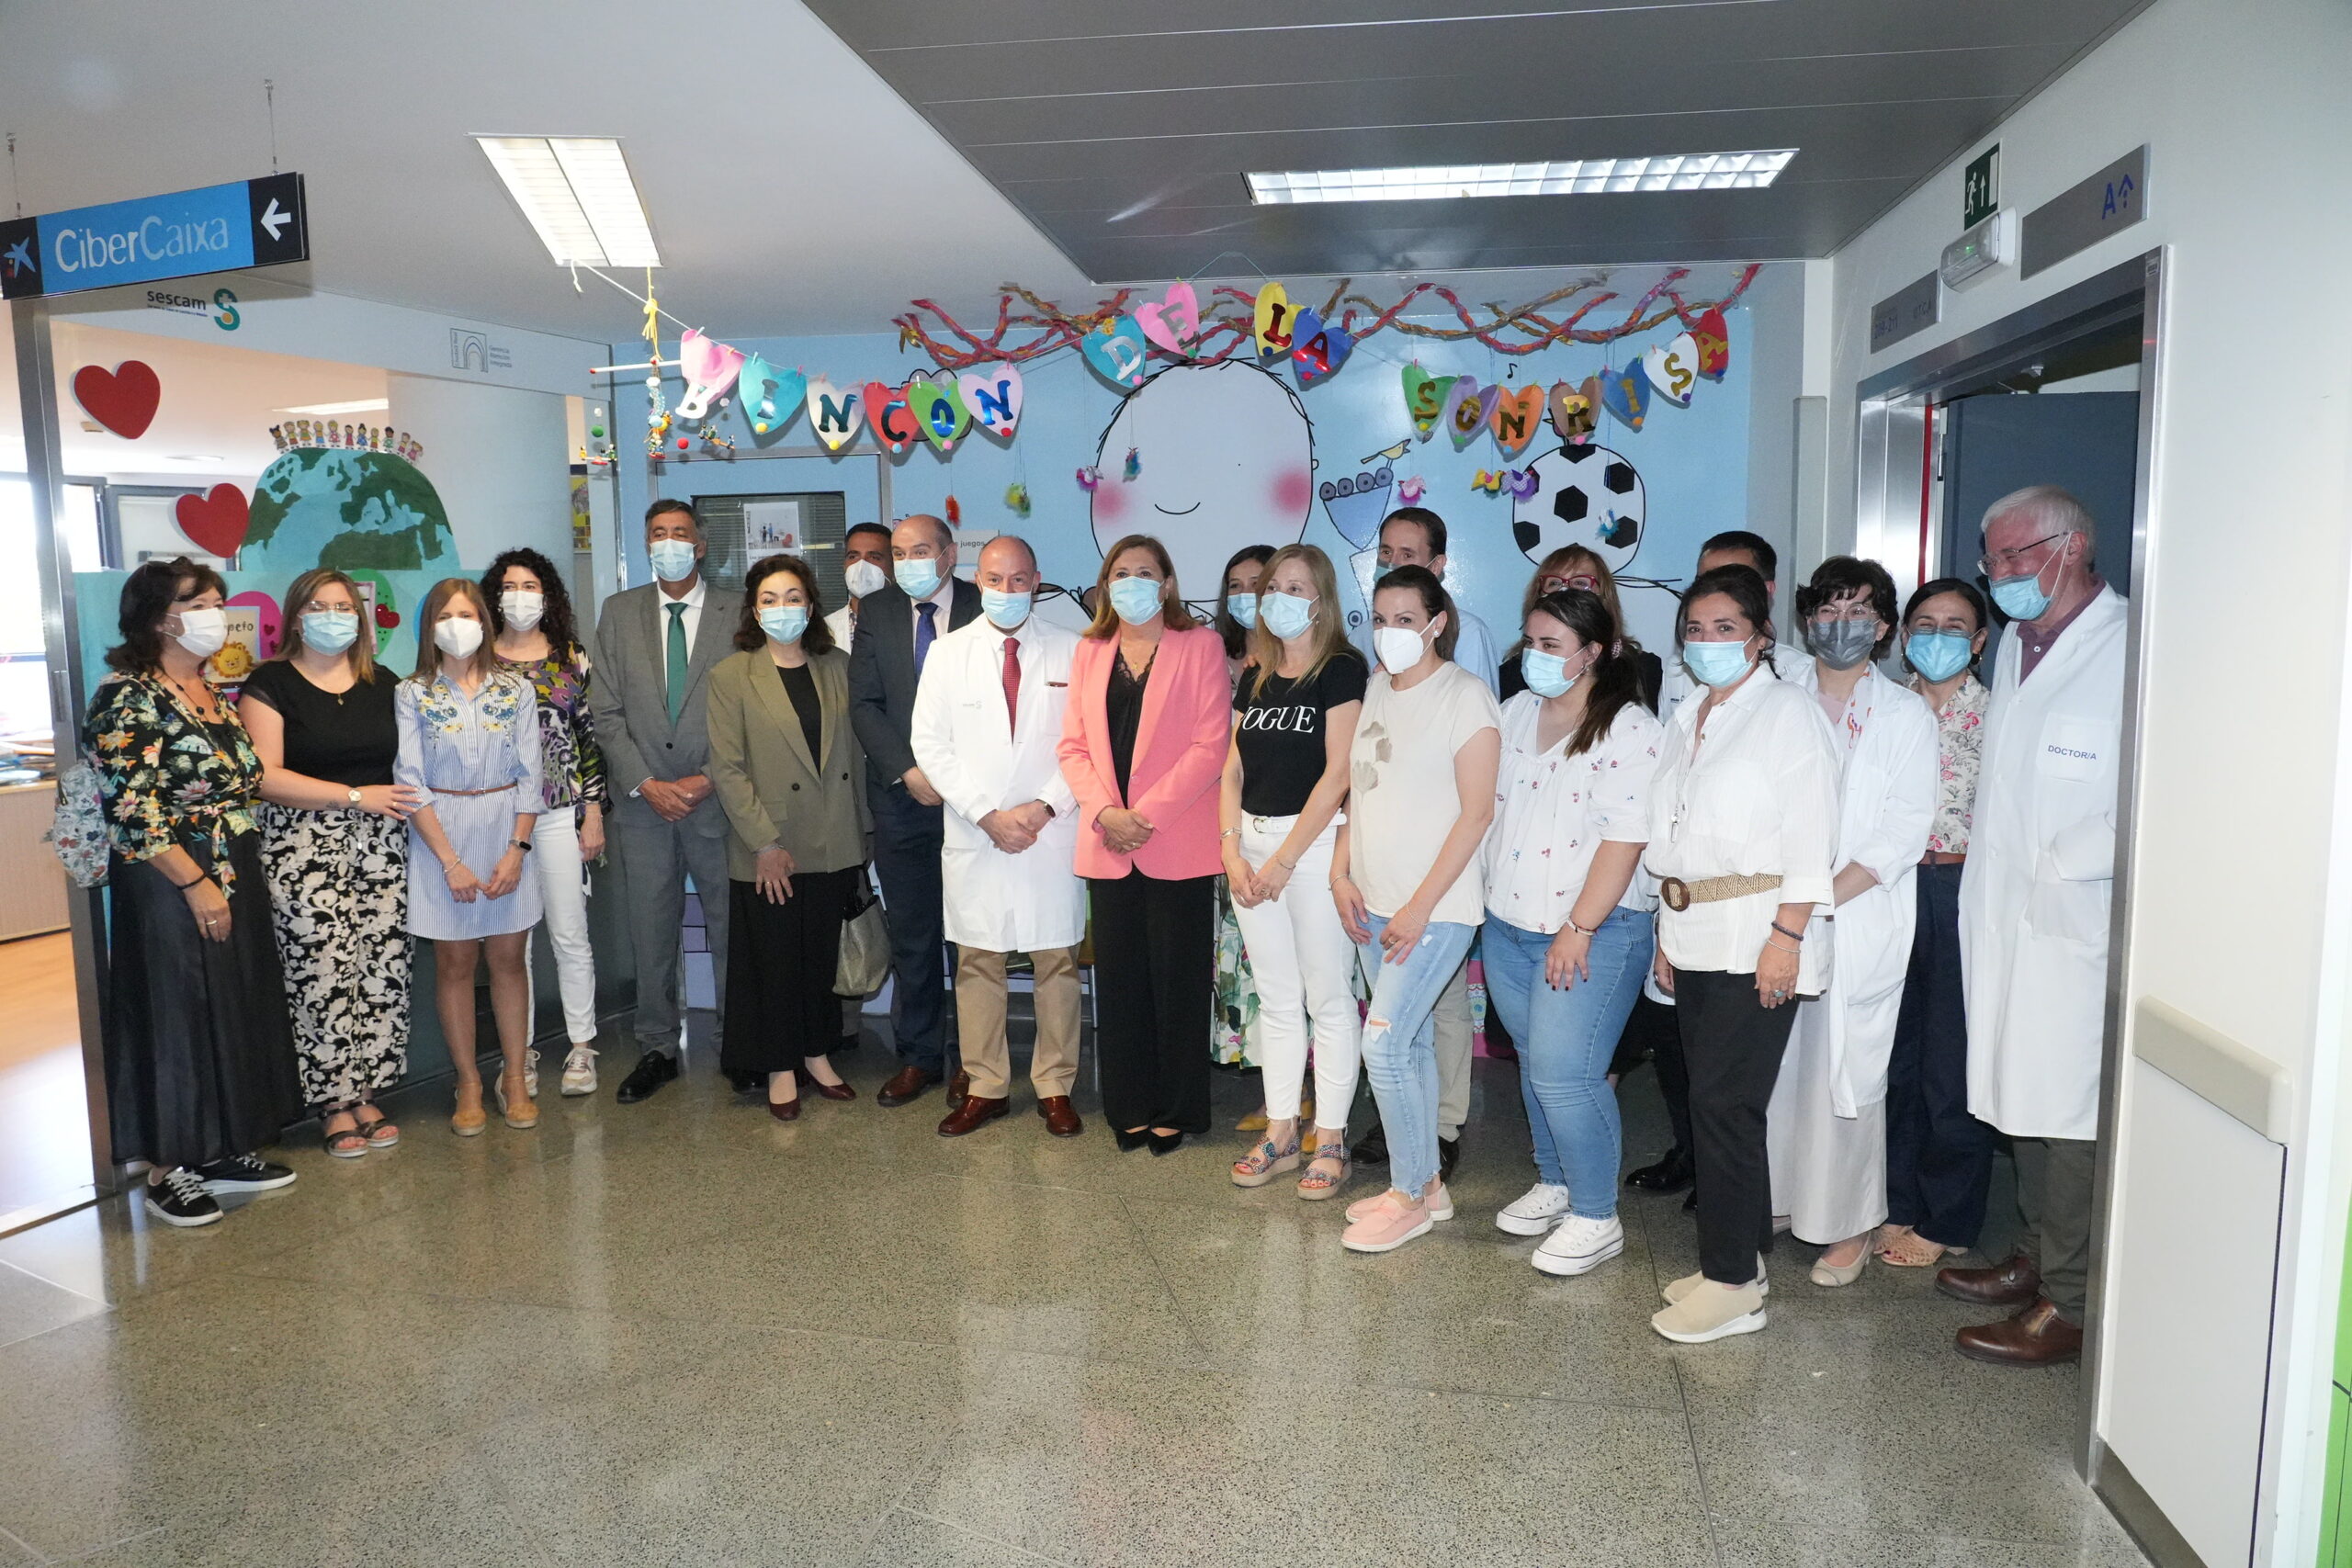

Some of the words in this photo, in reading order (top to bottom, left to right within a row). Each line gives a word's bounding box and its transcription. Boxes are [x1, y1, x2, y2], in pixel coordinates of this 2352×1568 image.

[55, 211, 229, 273] CiberCaixa
[147, 290, 207, 310] sescam
[960, 540, 986, 548] juegos
[227, 620, 254, 636] peto
[2048, 744, 2097, 761] DOCTOR/A
